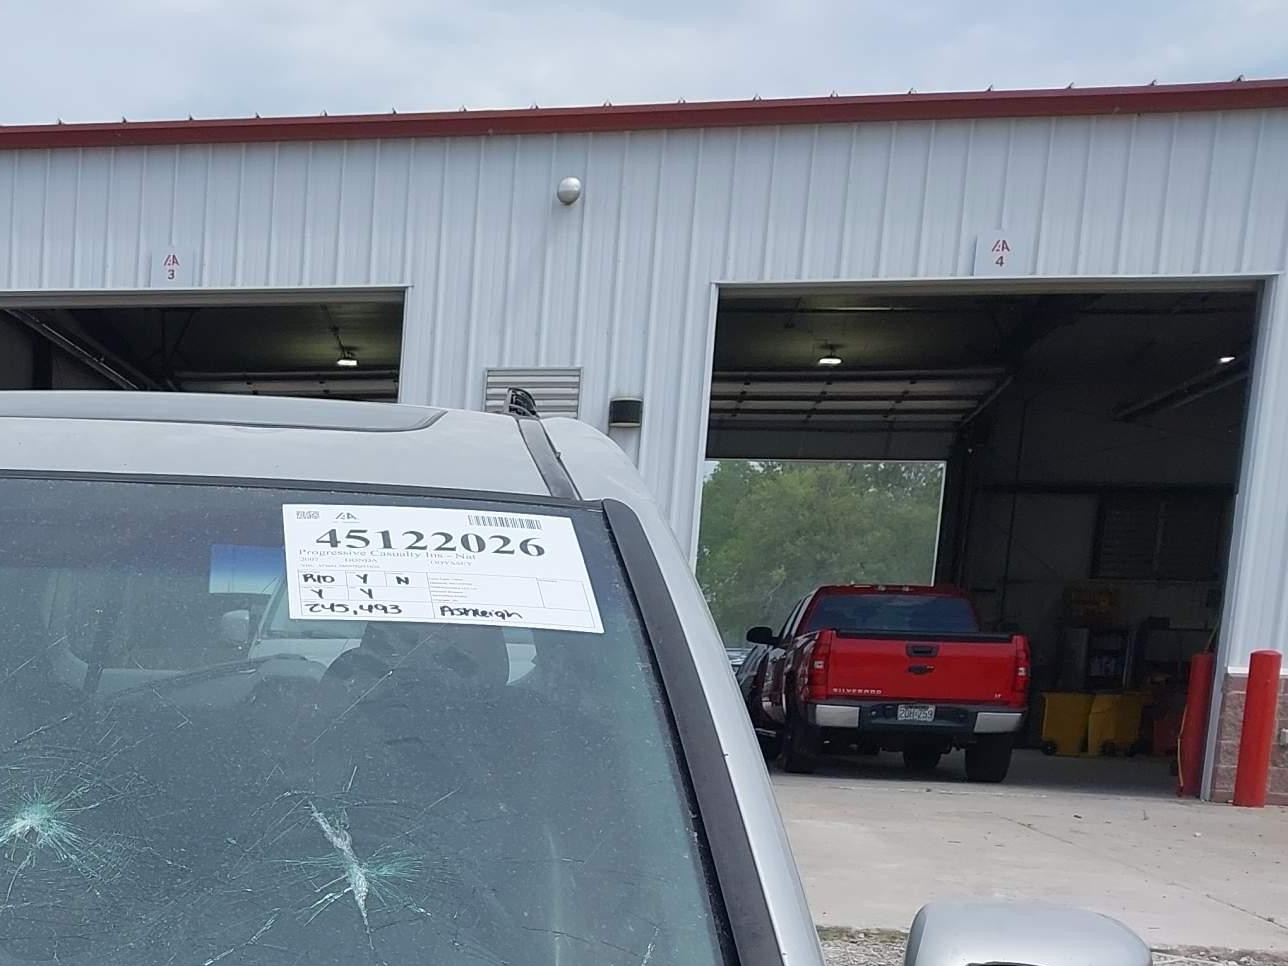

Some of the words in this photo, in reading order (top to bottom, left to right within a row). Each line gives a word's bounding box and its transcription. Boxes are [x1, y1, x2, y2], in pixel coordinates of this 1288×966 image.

[995, 255, 1005, 267] 4
[167, 269, 175, 280] 3
[315, 528, 546, 557] 45122026
[299, 549, 367, 558] Progressive
[370, 549, 422, 559] Casualty
[355, 573, 368, 584] Y
[395, 575, 410, 585] N
[310, 588, 324, 599] Y
[359, 587, 374, 599] Y
